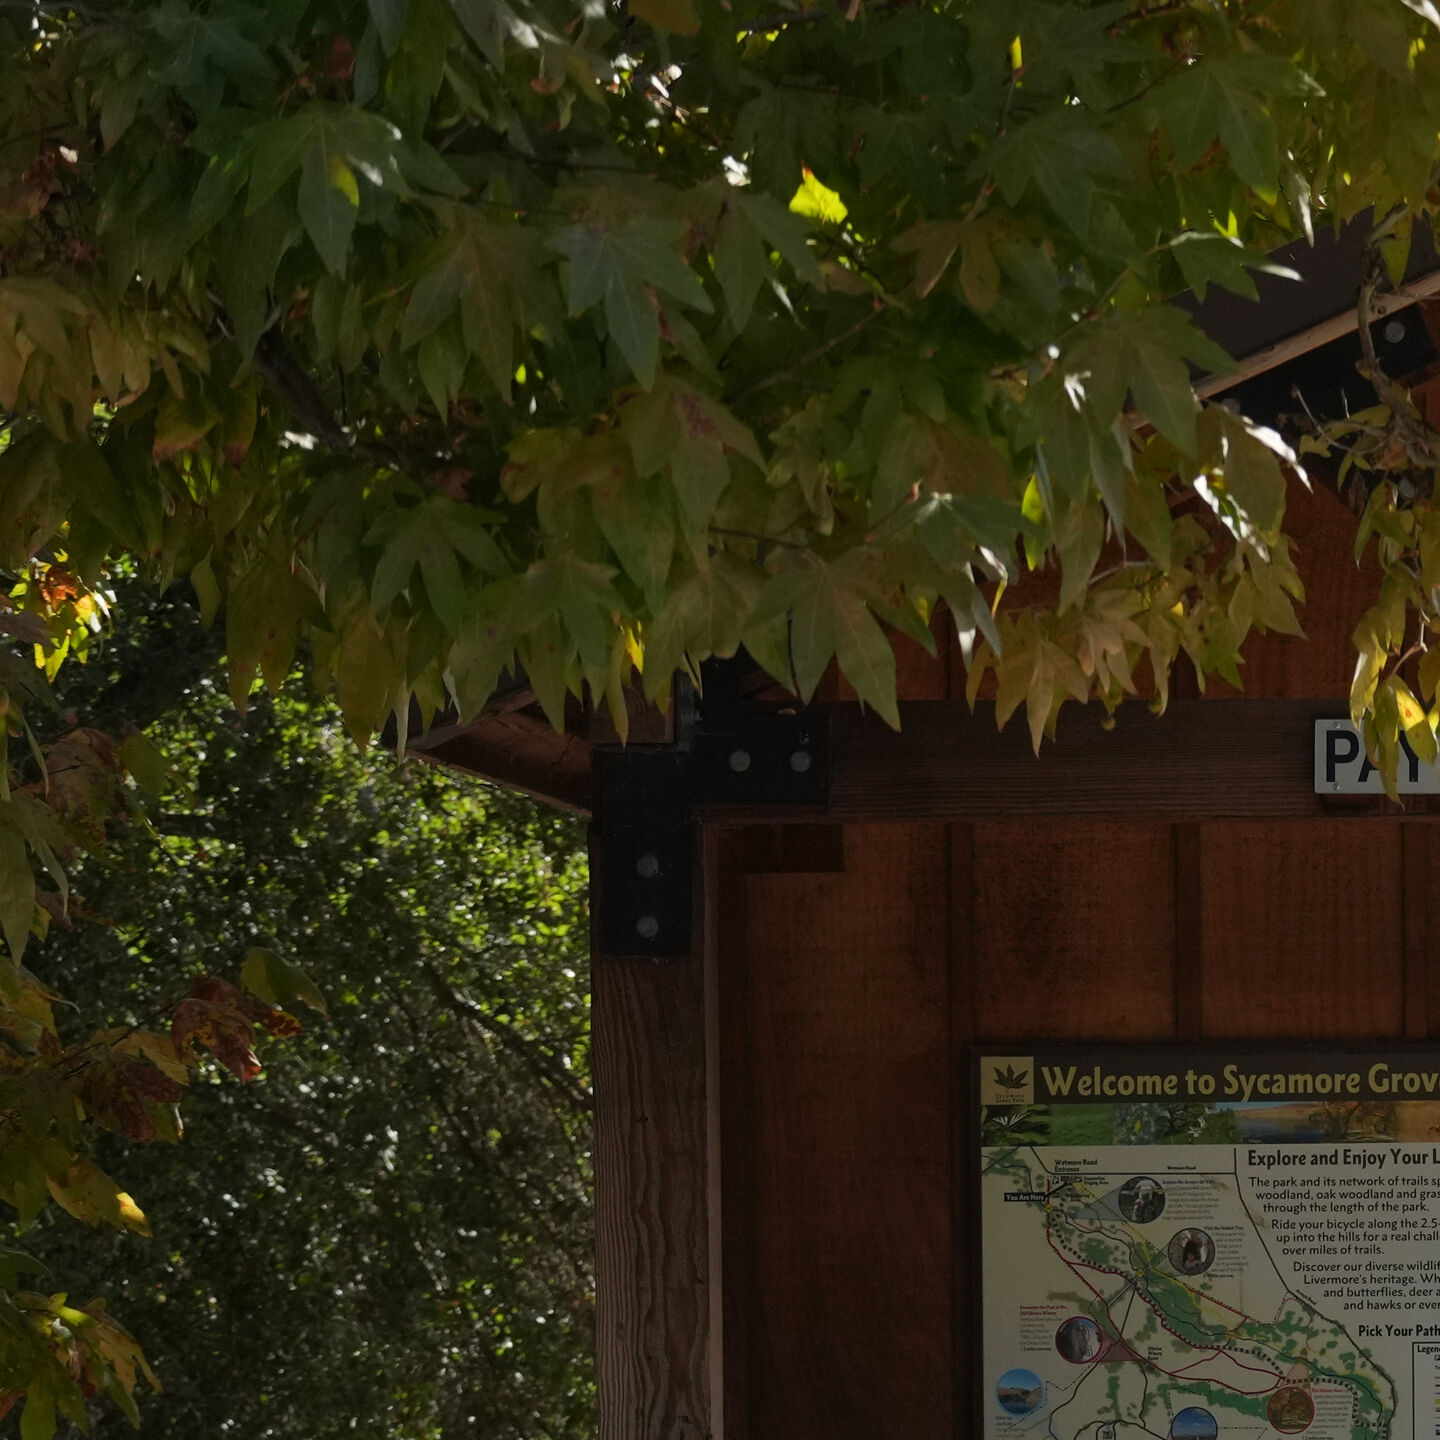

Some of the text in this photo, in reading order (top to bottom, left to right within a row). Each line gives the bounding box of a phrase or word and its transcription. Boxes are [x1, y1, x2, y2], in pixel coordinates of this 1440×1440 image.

[1041, 1065, 1177, 1095] Welcome
[1185, 1069, 1215, 1094] to
[1223, 1063, 1360, 1101] Sycamore
[1247, 1149, 1306, 1169] Explore
[1310, 1149, 1338, 1165] and
[1343, 1148, 1386, 1168] Enjoy
[1389, 1148, 1428, 1164] Your
[1248, 1176, 1269, 1187] The
[1272, 1176, 1297, 1188] park
[1299, 1176, 1320, 1186] and
[1323, 1176, 1336, 1186] its
[1339, 1175, 1385, 1186] network
[1387, 1175, 1399, 1185] of
[1401, 1175, 1428, 1185] trails
[1255, 1188, 1313, 1200] woodland,
[1316, 1188, 1336, 1199] oak
[1338, 1188, 1393, 1199] woodland
[1396, 1188, 1416, 1198] and
[1262, 1200, 1429, 1214] through the length of the park.
[1293, 1261, 1341, 1272] Discover
[1365, 1260, 1403, 1271] diverse
[1303, 1274, 1367, 1284] Livermore's
[1370, 1273, 1416, 1286] heritage.
[1323, 1287, 1343, 1297] and
[1346, 1286, 1405, 1297] butterflies,
[1408, 1286, 1433, 1296] deer
[1343, 1299, 1363, 1310] and
[1366, 1299, 1401, 1309] hawks
[1358, 1324, 1382, 1336] Pick
[1384, 1324, 1413, 1336] Your
[1416, 1324, 1440, 1336] Path
